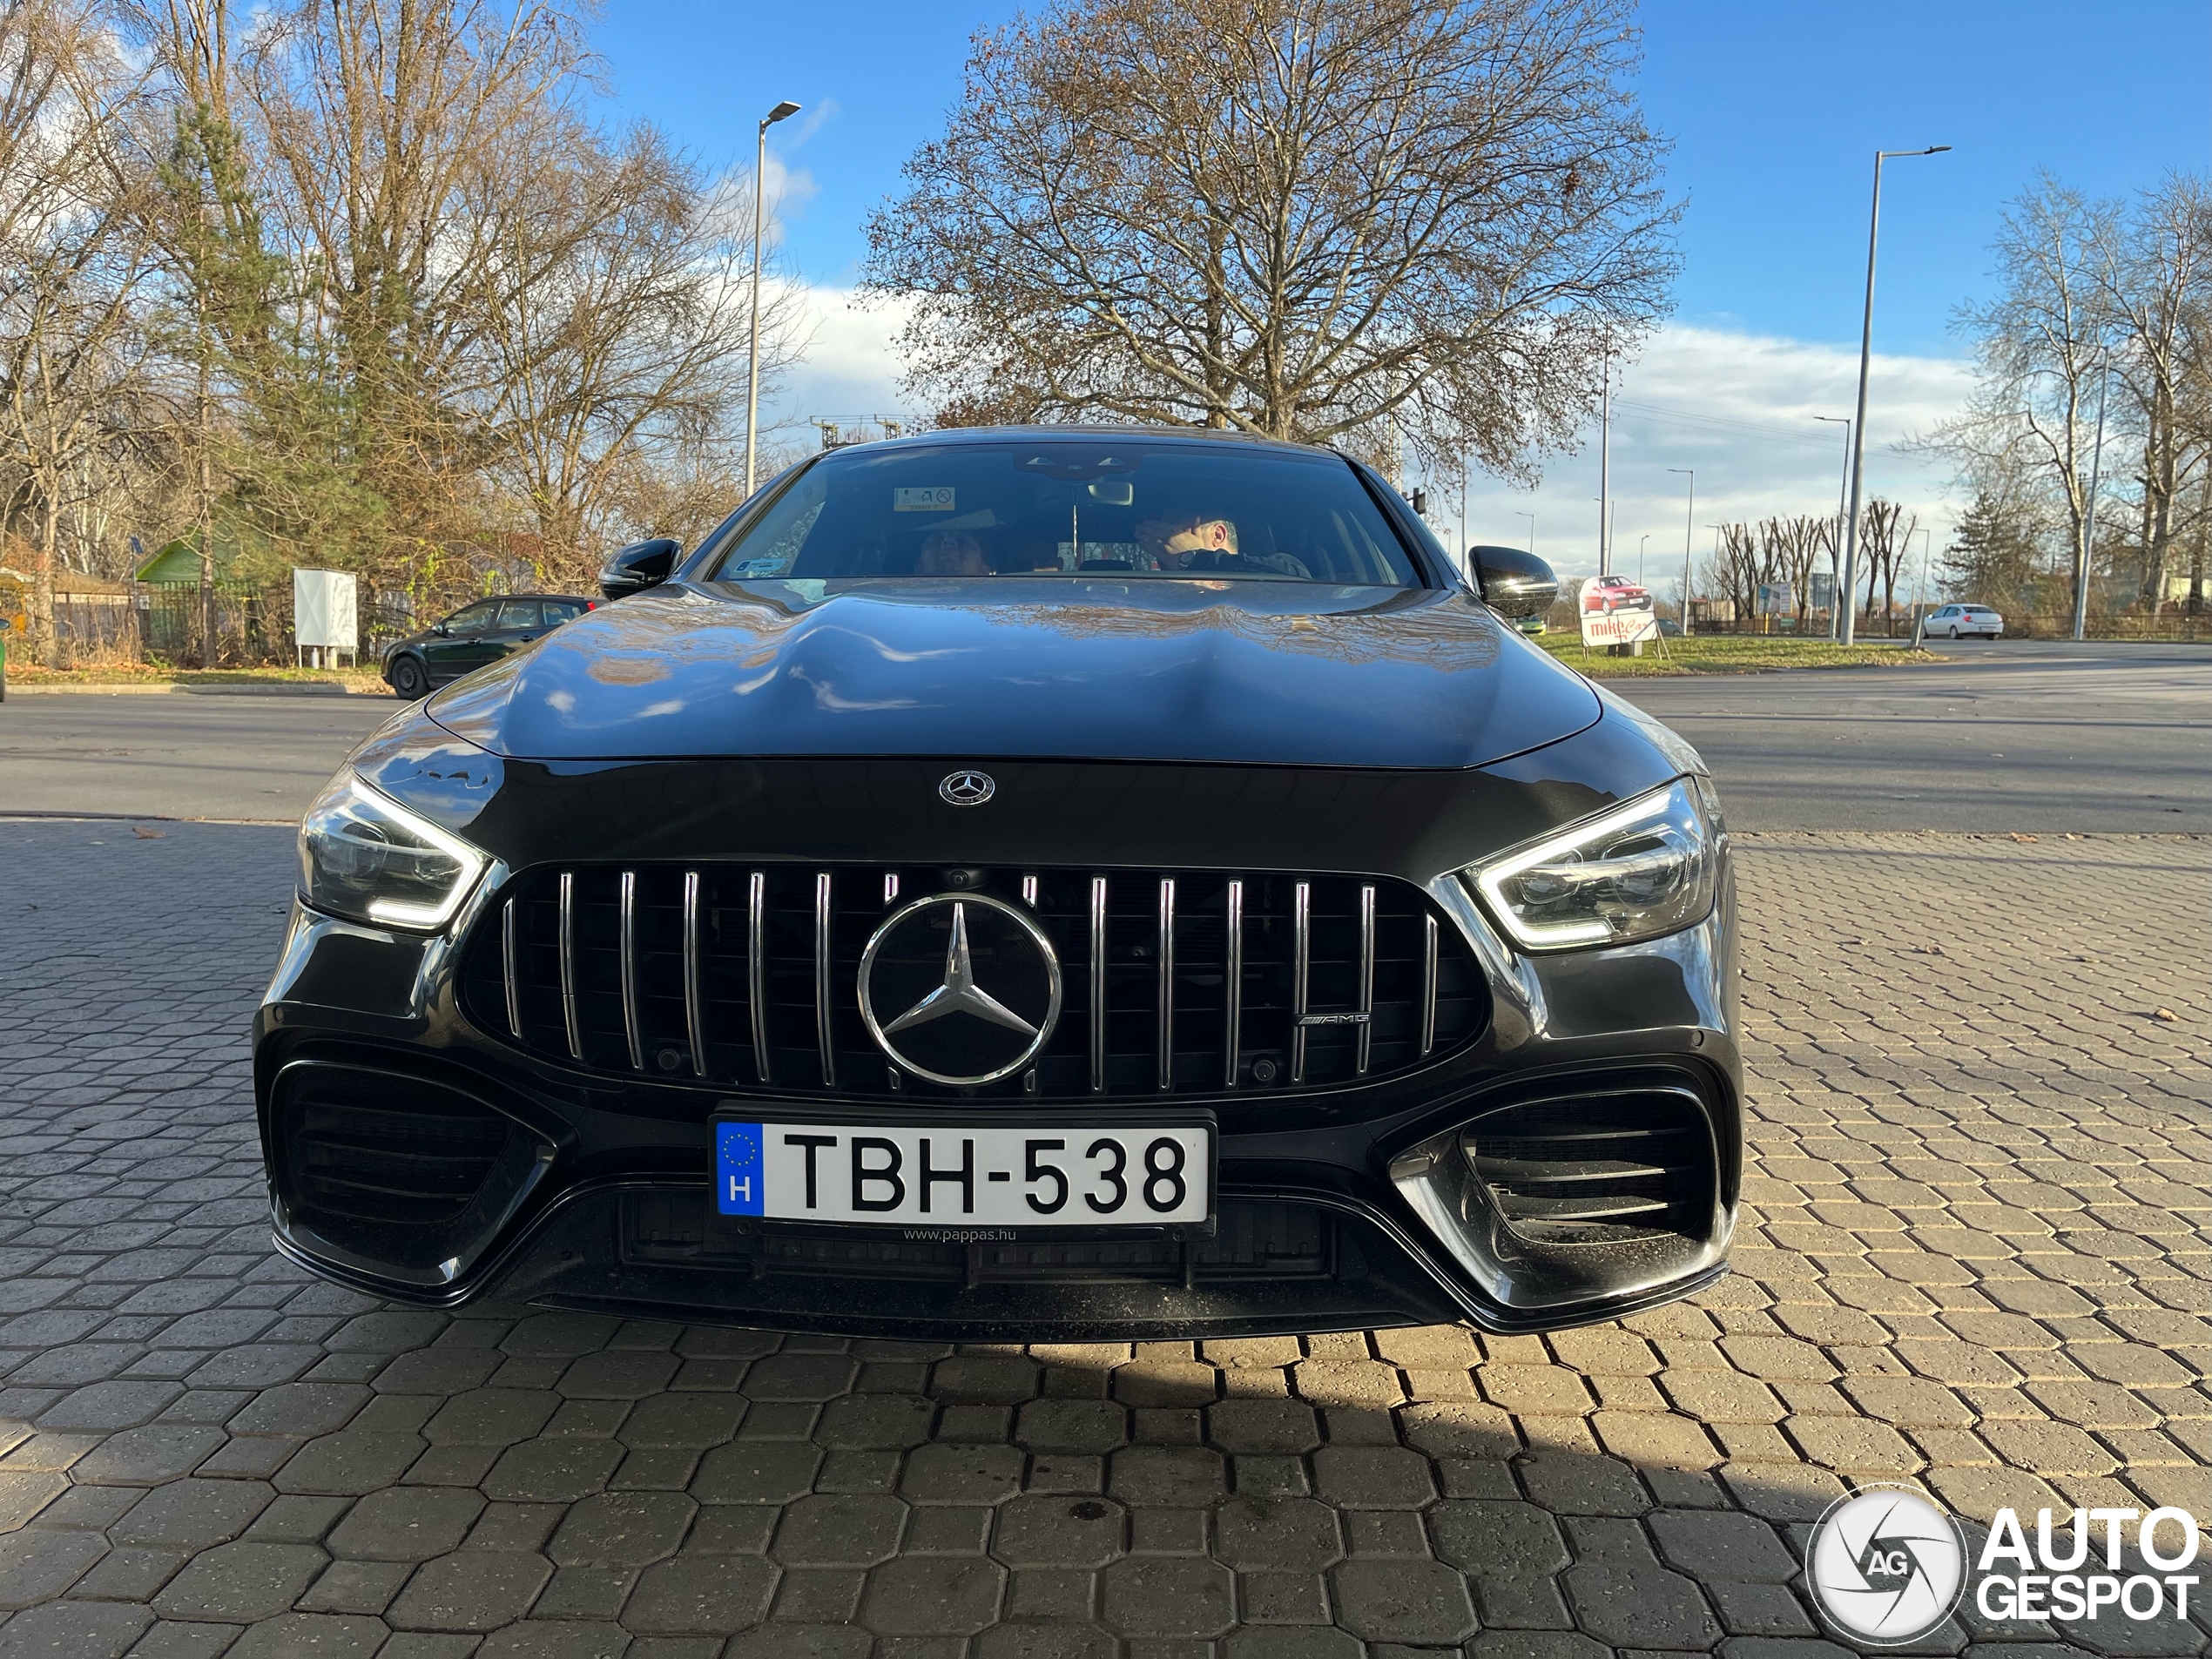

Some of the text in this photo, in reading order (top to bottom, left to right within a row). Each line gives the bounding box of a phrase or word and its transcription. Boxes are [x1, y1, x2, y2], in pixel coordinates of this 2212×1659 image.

[1590, 617, 1625, 637] mike
[1319, 1015, 1370, 1024] AMG
[784, 1134, 1188, 1215] TBH-538
[729, 1176, 751, 1202] H
[903, 1228, 1017, 1243] www.pappas.hu
